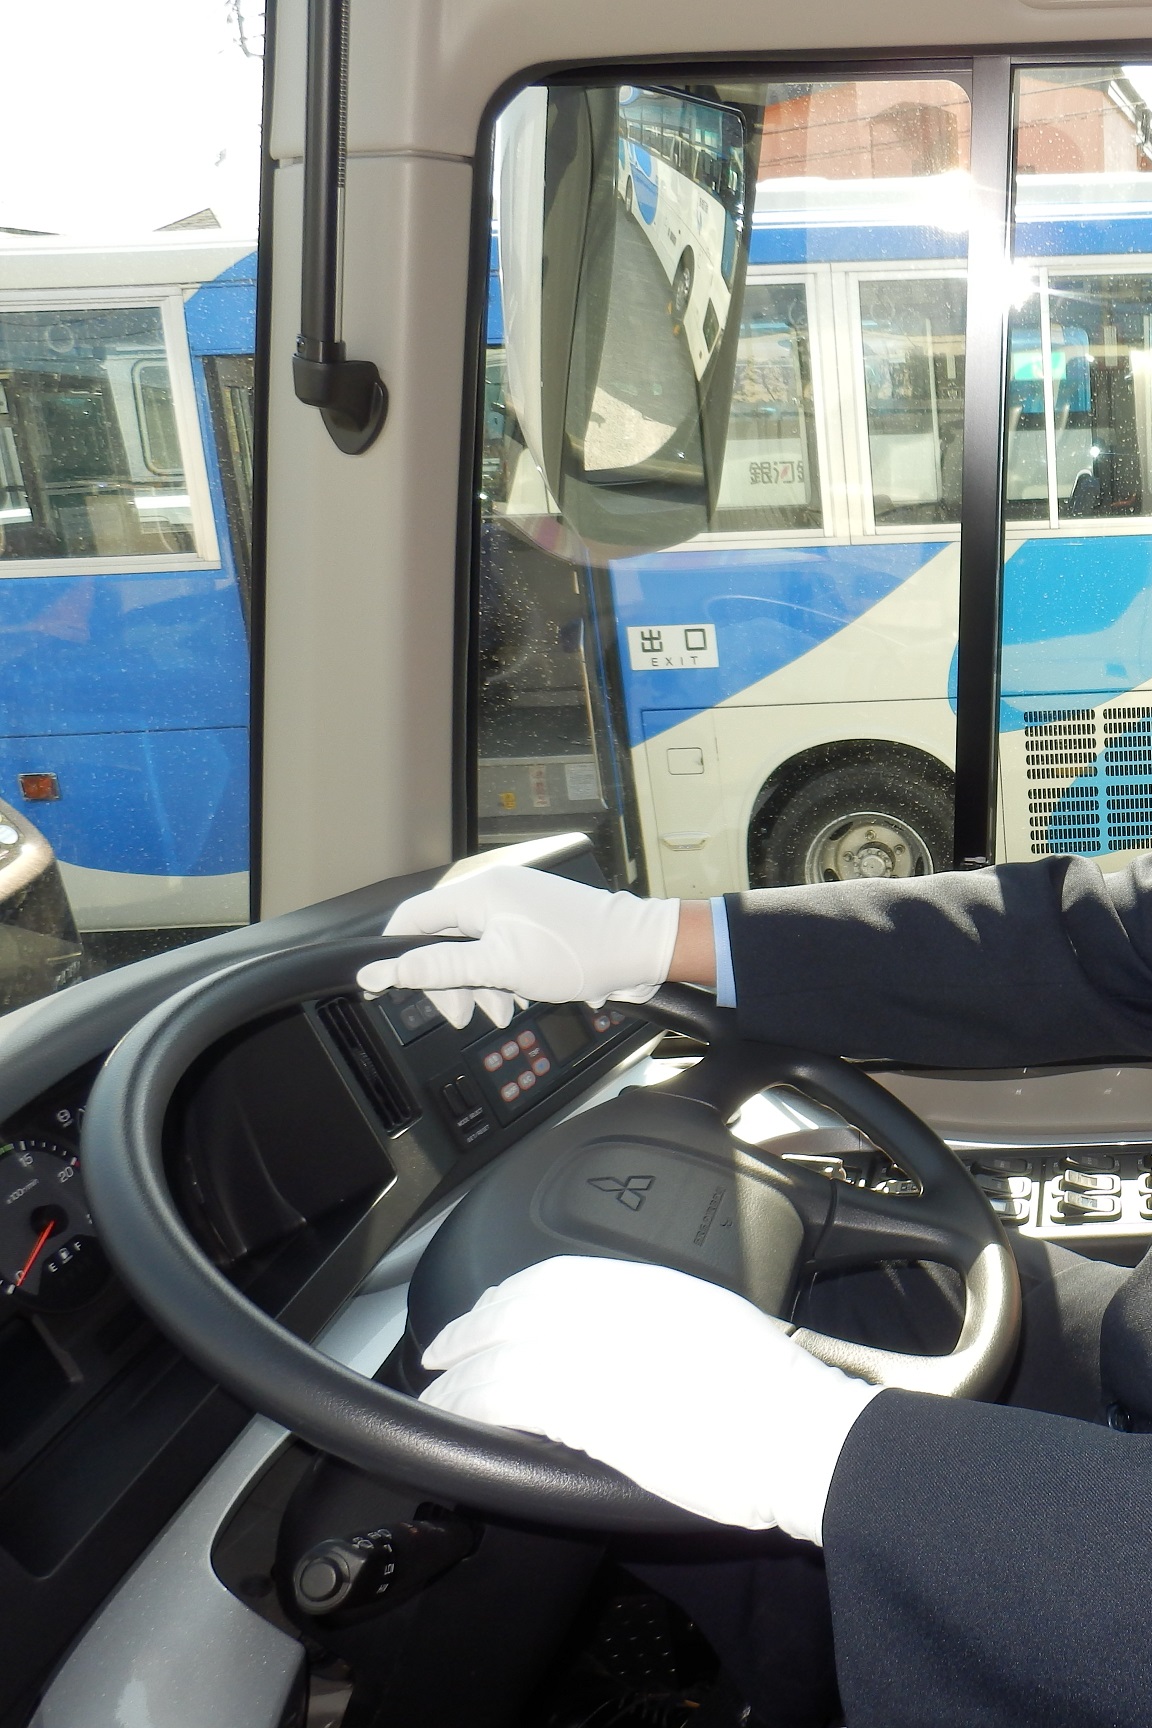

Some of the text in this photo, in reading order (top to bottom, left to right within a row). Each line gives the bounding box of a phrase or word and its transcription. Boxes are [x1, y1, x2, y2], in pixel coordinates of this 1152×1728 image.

[640, 628, 708, 653] 出口
[651, 655, 699, 667] EXIT
[19, 1152, 34, 1168] 15
[57, 1166, 74, 1183] 20
[74, 1241, 82, 1251] F
[48, 1262, 59, 1273] E
